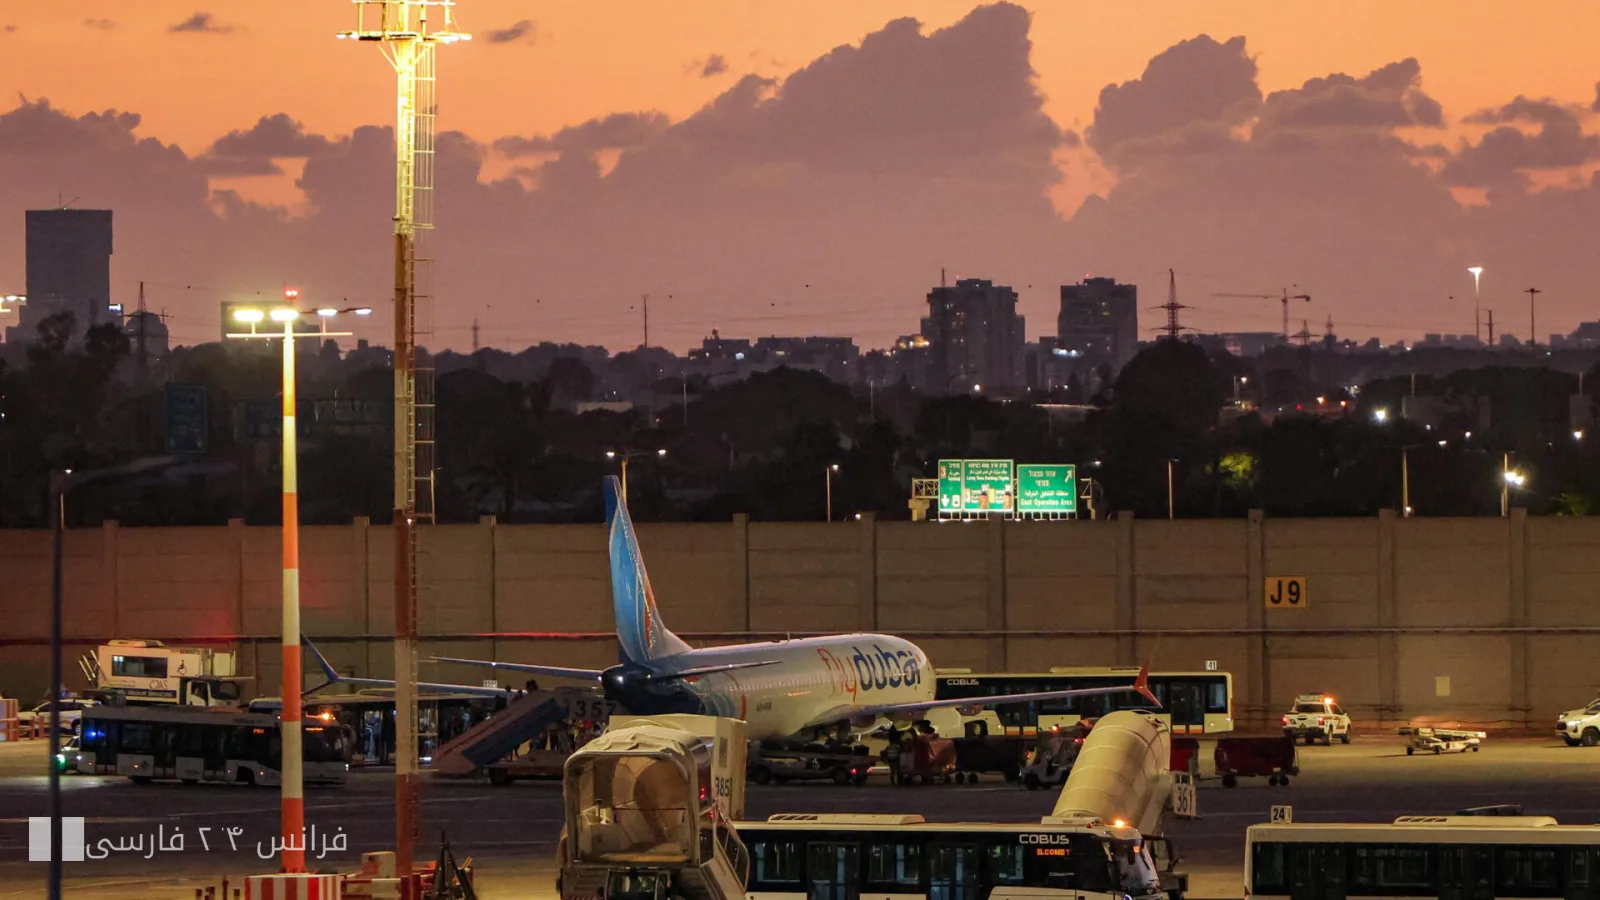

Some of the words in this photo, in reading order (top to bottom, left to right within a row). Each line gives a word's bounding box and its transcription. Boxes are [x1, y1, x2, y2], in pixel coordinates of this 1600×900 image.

[1269, 579, 1301, 606] J9
[816, 644, 921, 703] flydubai
[946, 678, 979, 686] COBUS
[715, 776, 730, 797] 385
[1177, 785, 1192, 814] 361
[1019, 834, 1070, 845] COBUS
